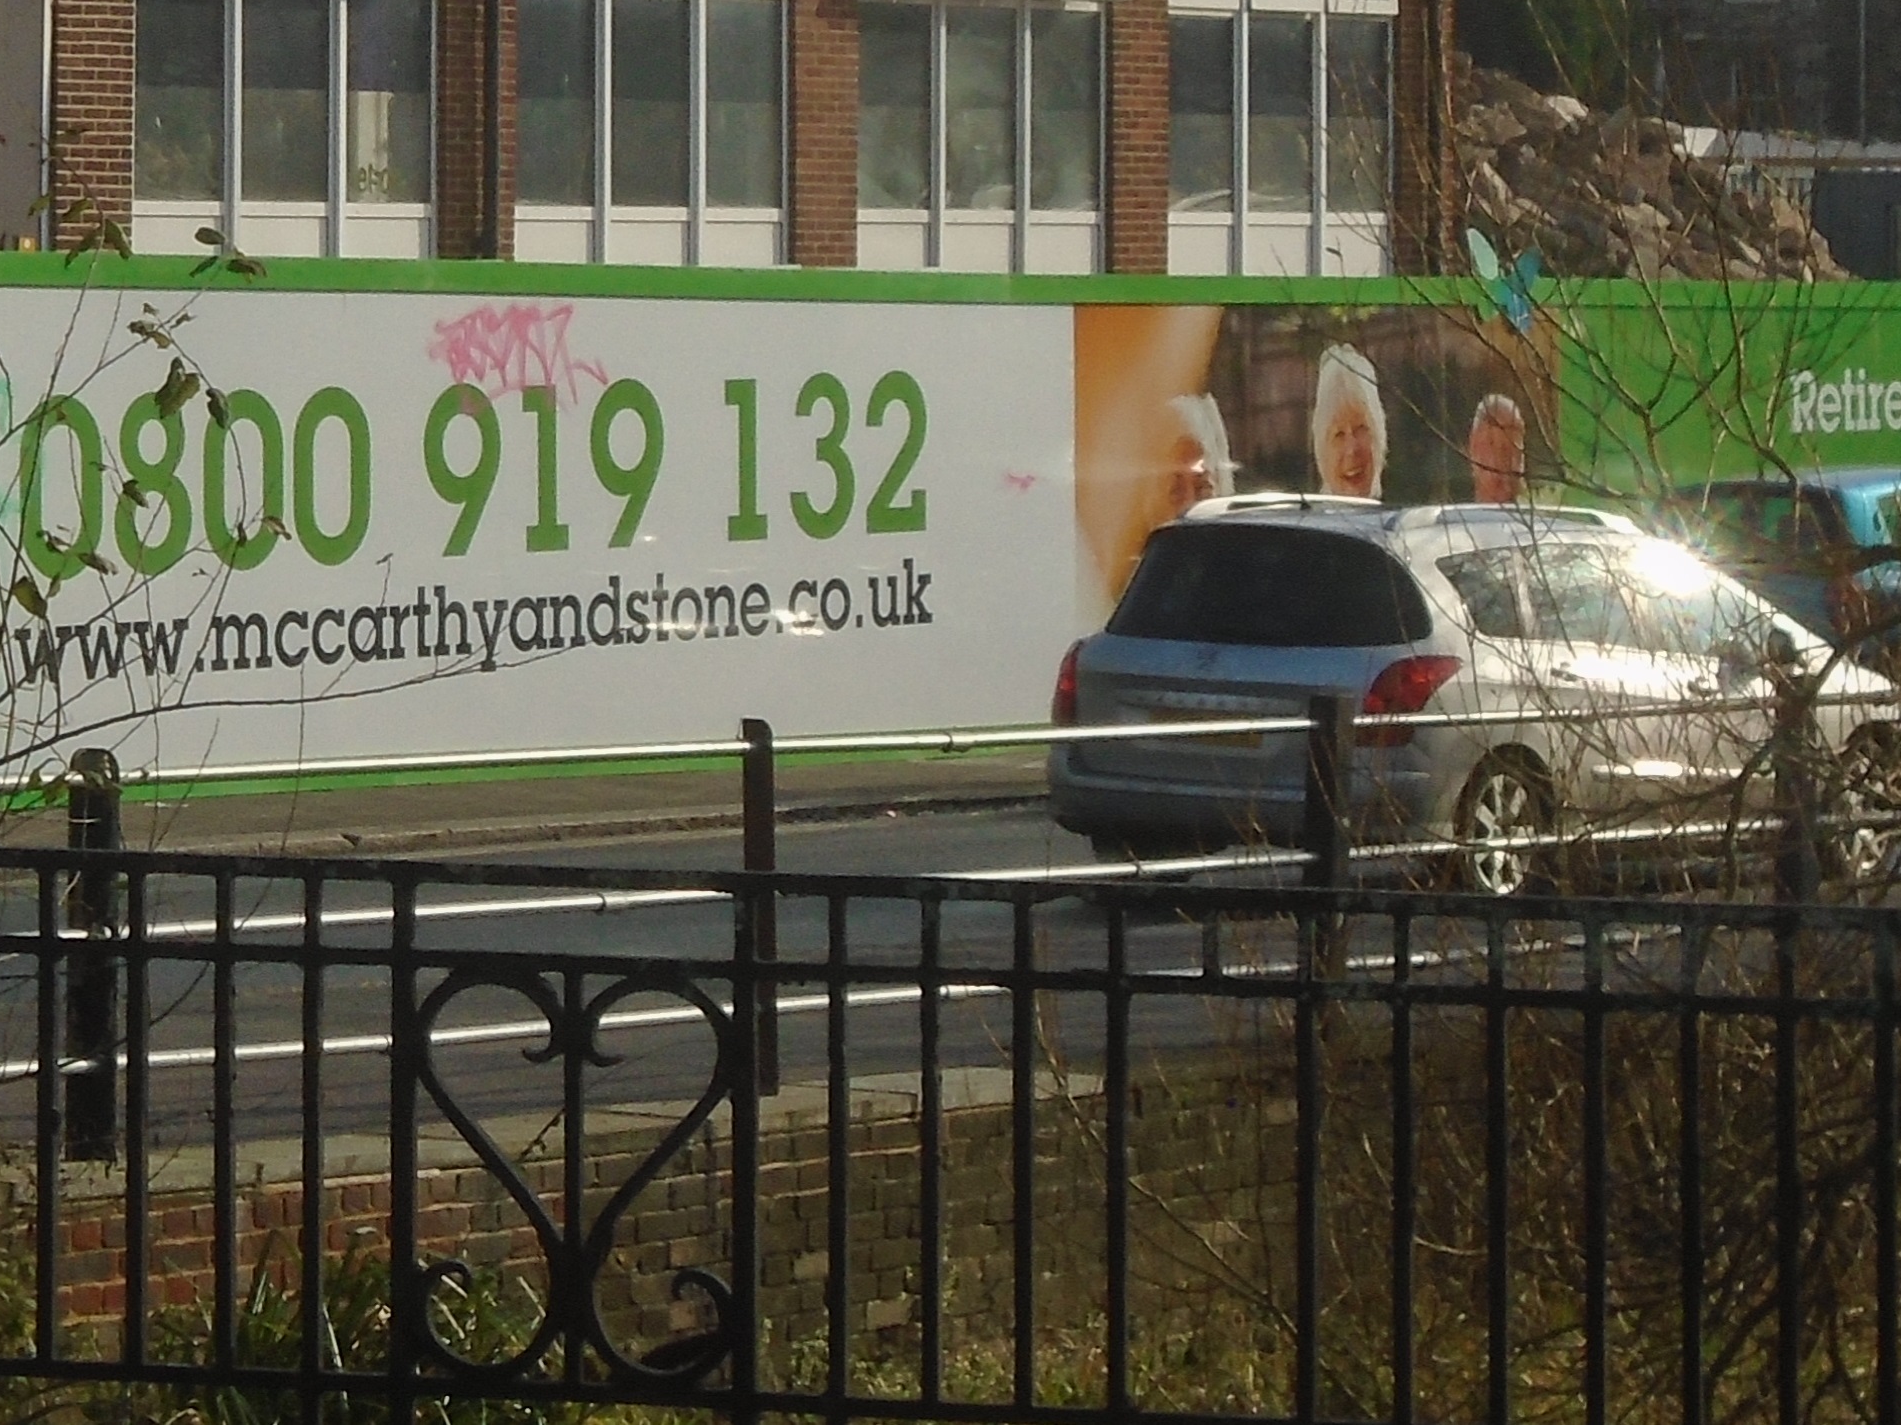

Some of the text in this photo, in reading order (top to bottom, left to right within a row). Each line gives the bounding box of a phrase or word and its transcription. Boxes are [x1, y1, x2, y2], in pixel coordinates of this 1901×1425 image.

[19, 387, 371, 580] 0800
[423, 377, 665, 558] 919
[724, 370, 929, 542] 132
[13, 559, 934, 685] www.mccarthyandstone.co.uk
